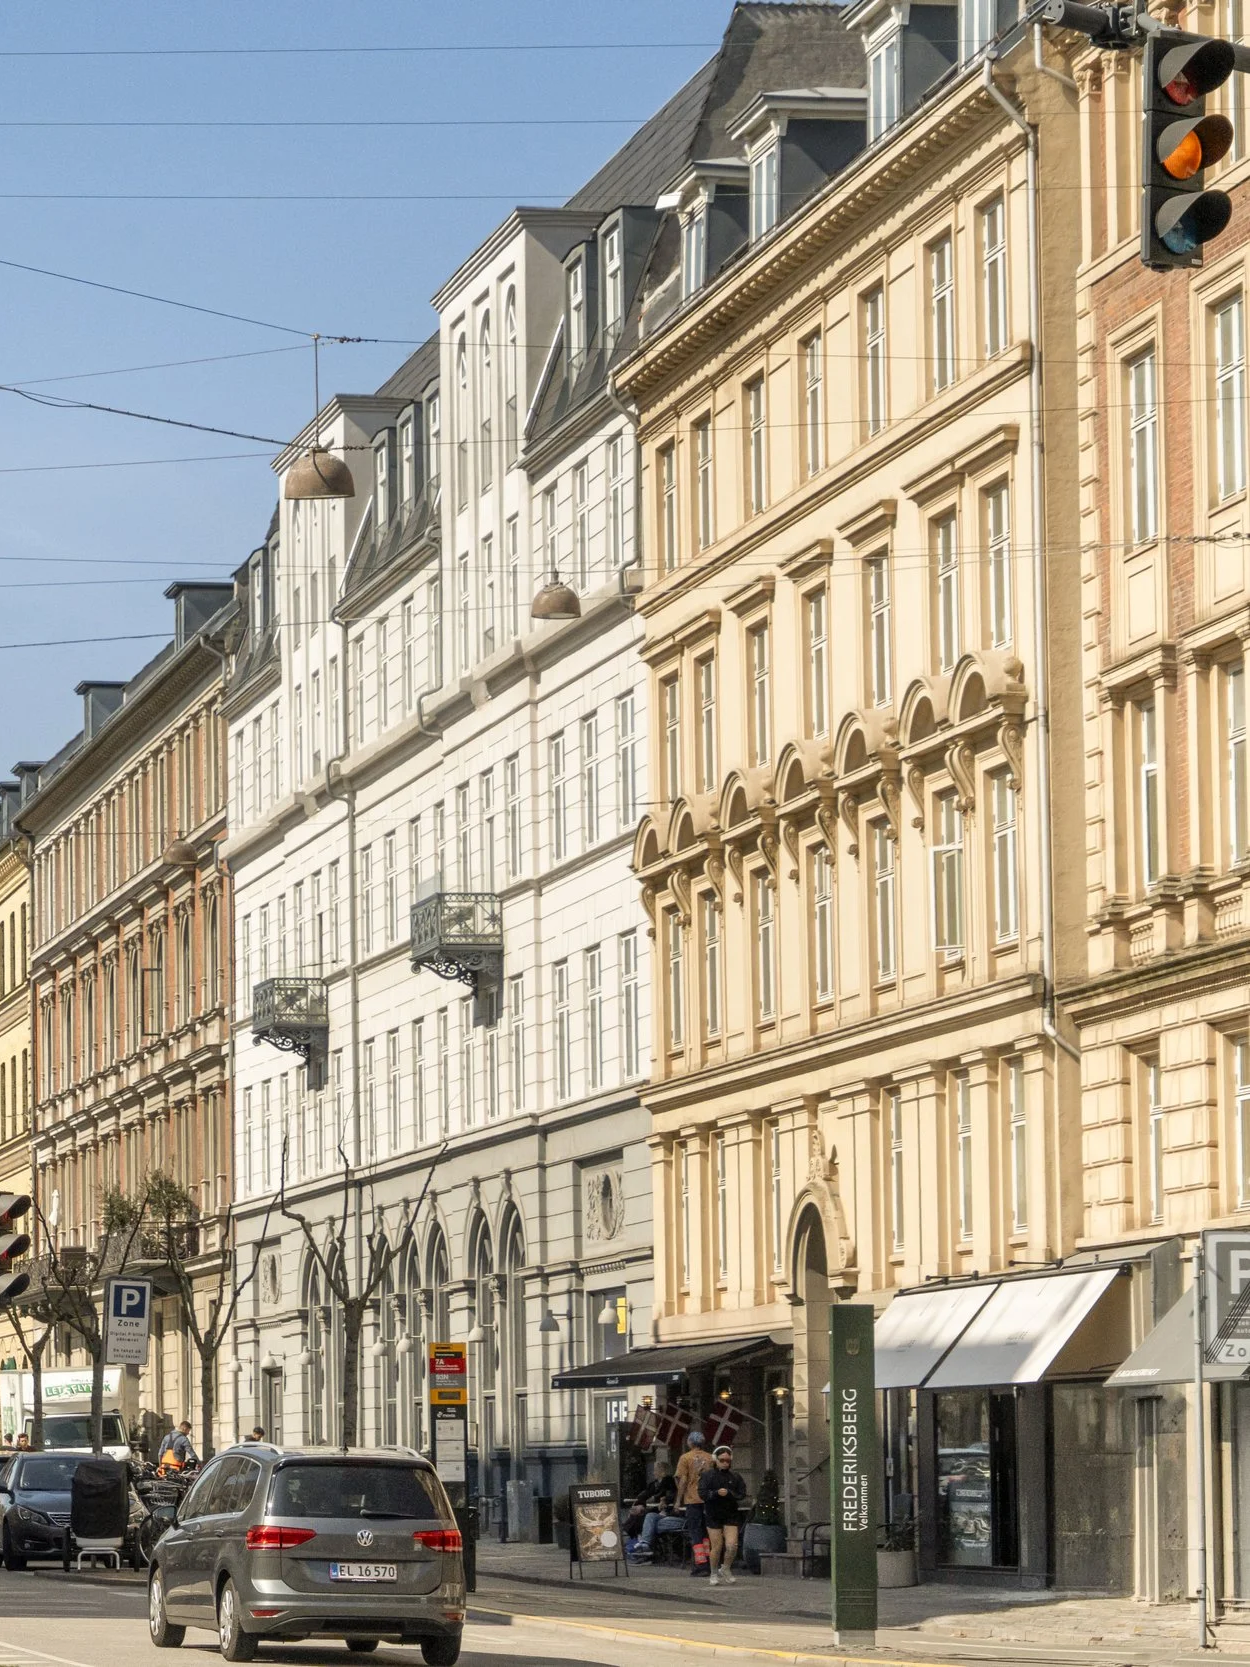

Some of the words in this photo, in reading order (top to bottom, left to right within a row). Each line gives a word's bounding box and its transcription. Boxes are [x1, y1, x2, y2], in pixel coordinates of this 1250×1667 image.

[121, 1288, 140, 1315] P
[118, 1319, 140, 1328] Zone
[842, 1388, 858, 1531] FREDERIKSBERG
[577, 1489, 611, 1499] TUBORG
[859, 1474, 869, 1531] Velkommen
[339, 1565, 354, 1577] EL
[358, 1565, 372, 1577] 16
[374, 1566, 396, 1578] 570
